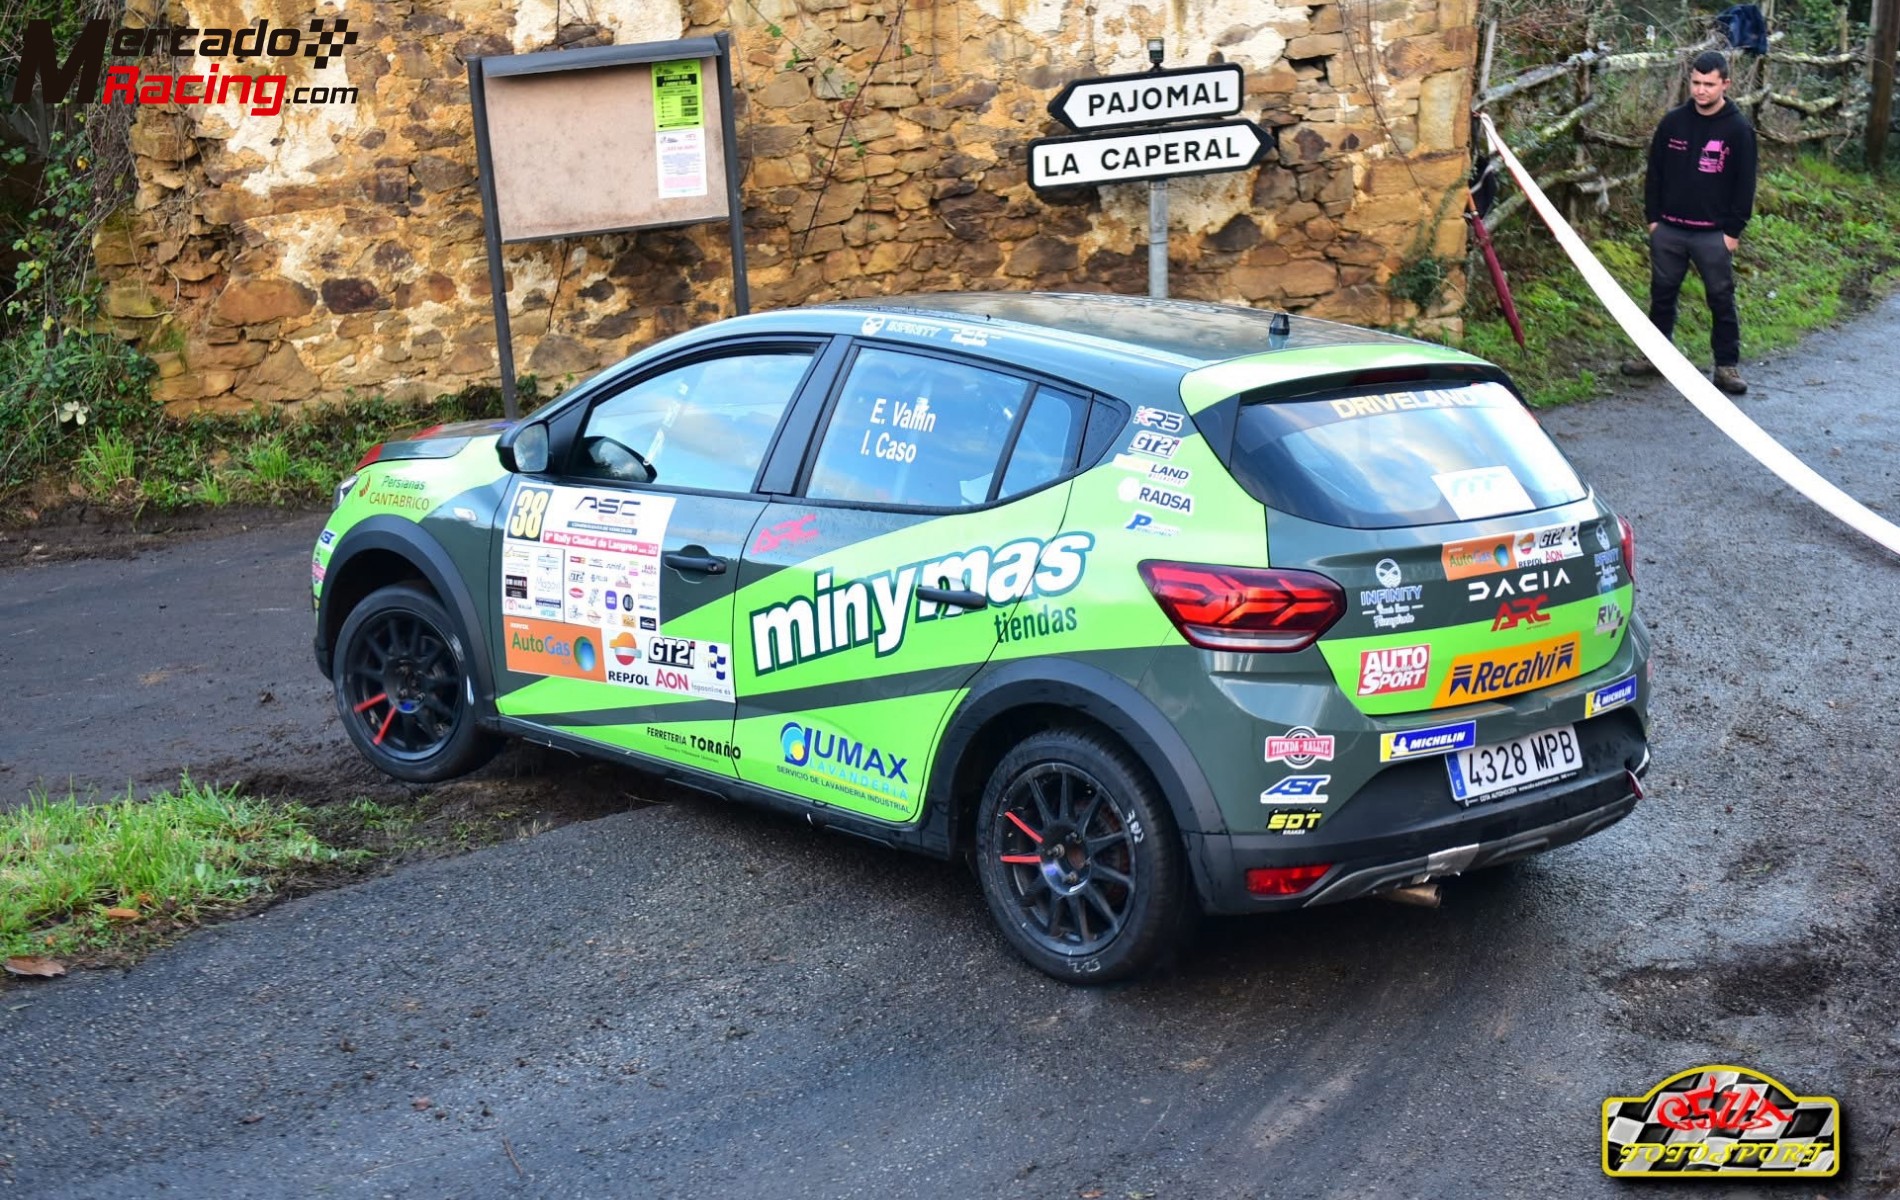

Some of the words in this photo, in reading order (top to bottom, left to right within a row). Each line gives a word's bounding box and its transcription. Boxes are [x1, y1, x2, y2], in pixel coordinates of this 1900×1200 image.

[1088, 81, 1229, 117] PAJOMAL
[1044, 153, 1080, 177] LA
[1100, 137, 1240, 171] CAPERAL
[870, 398, 887, 425] E.
[1330, 390, 1481, 419] DRIVELAND
[860, 430, 870, 455] I.
[875, 432, 917, 464] Caso
[381, 475, 426, 490] Persianas
[1151, 464, 1189, 480] LAND
[510, 489, 549, 538] 38
[1139, 487, 1191, 512] RADSA
[554, 533, 571, 545] Rally
[608, 538, 638, 553] Langreo
[1361, 585, 1423, 606] INFINITY
[1469, 568, 1571, 601] DACIA
[751, 532, 1094, 676] minymas
[1491, 594, 1551, 631] ARC
[994, 606, 1078, 643] tiendas
[512, 631, 571, 657] AutoGas
[1363, 646, 1427, 675] AUTO
[1471, 645, 1557, 695] Recalvi
[608, 670, 650, 686] REPSOL
[655, 668, 689, 691] AON
[1358, 668, 1426, 695] SPORT
[1601, 686, 1632, 706] MICHELIN
[646, 726, 687, 745] FERRETERIA
[690, 735, 741, 760] TORAÑO
[1410, 731, 1466, 749] MICHELIN
[1469, 742, 1527, 788] 4328
[1530, 730, 1575, 772] MPB
[776, 765, 809, 780] SERVICIO
[809, 776, 820, 785] DE
[821, 778, 867, 799] LAVANDERIA
[867, 793, 911, 814] INDUSTRIAL
[809, 759, 908, 800] LAVANDERIA
[1267, 812, 1323, 830] SDT
